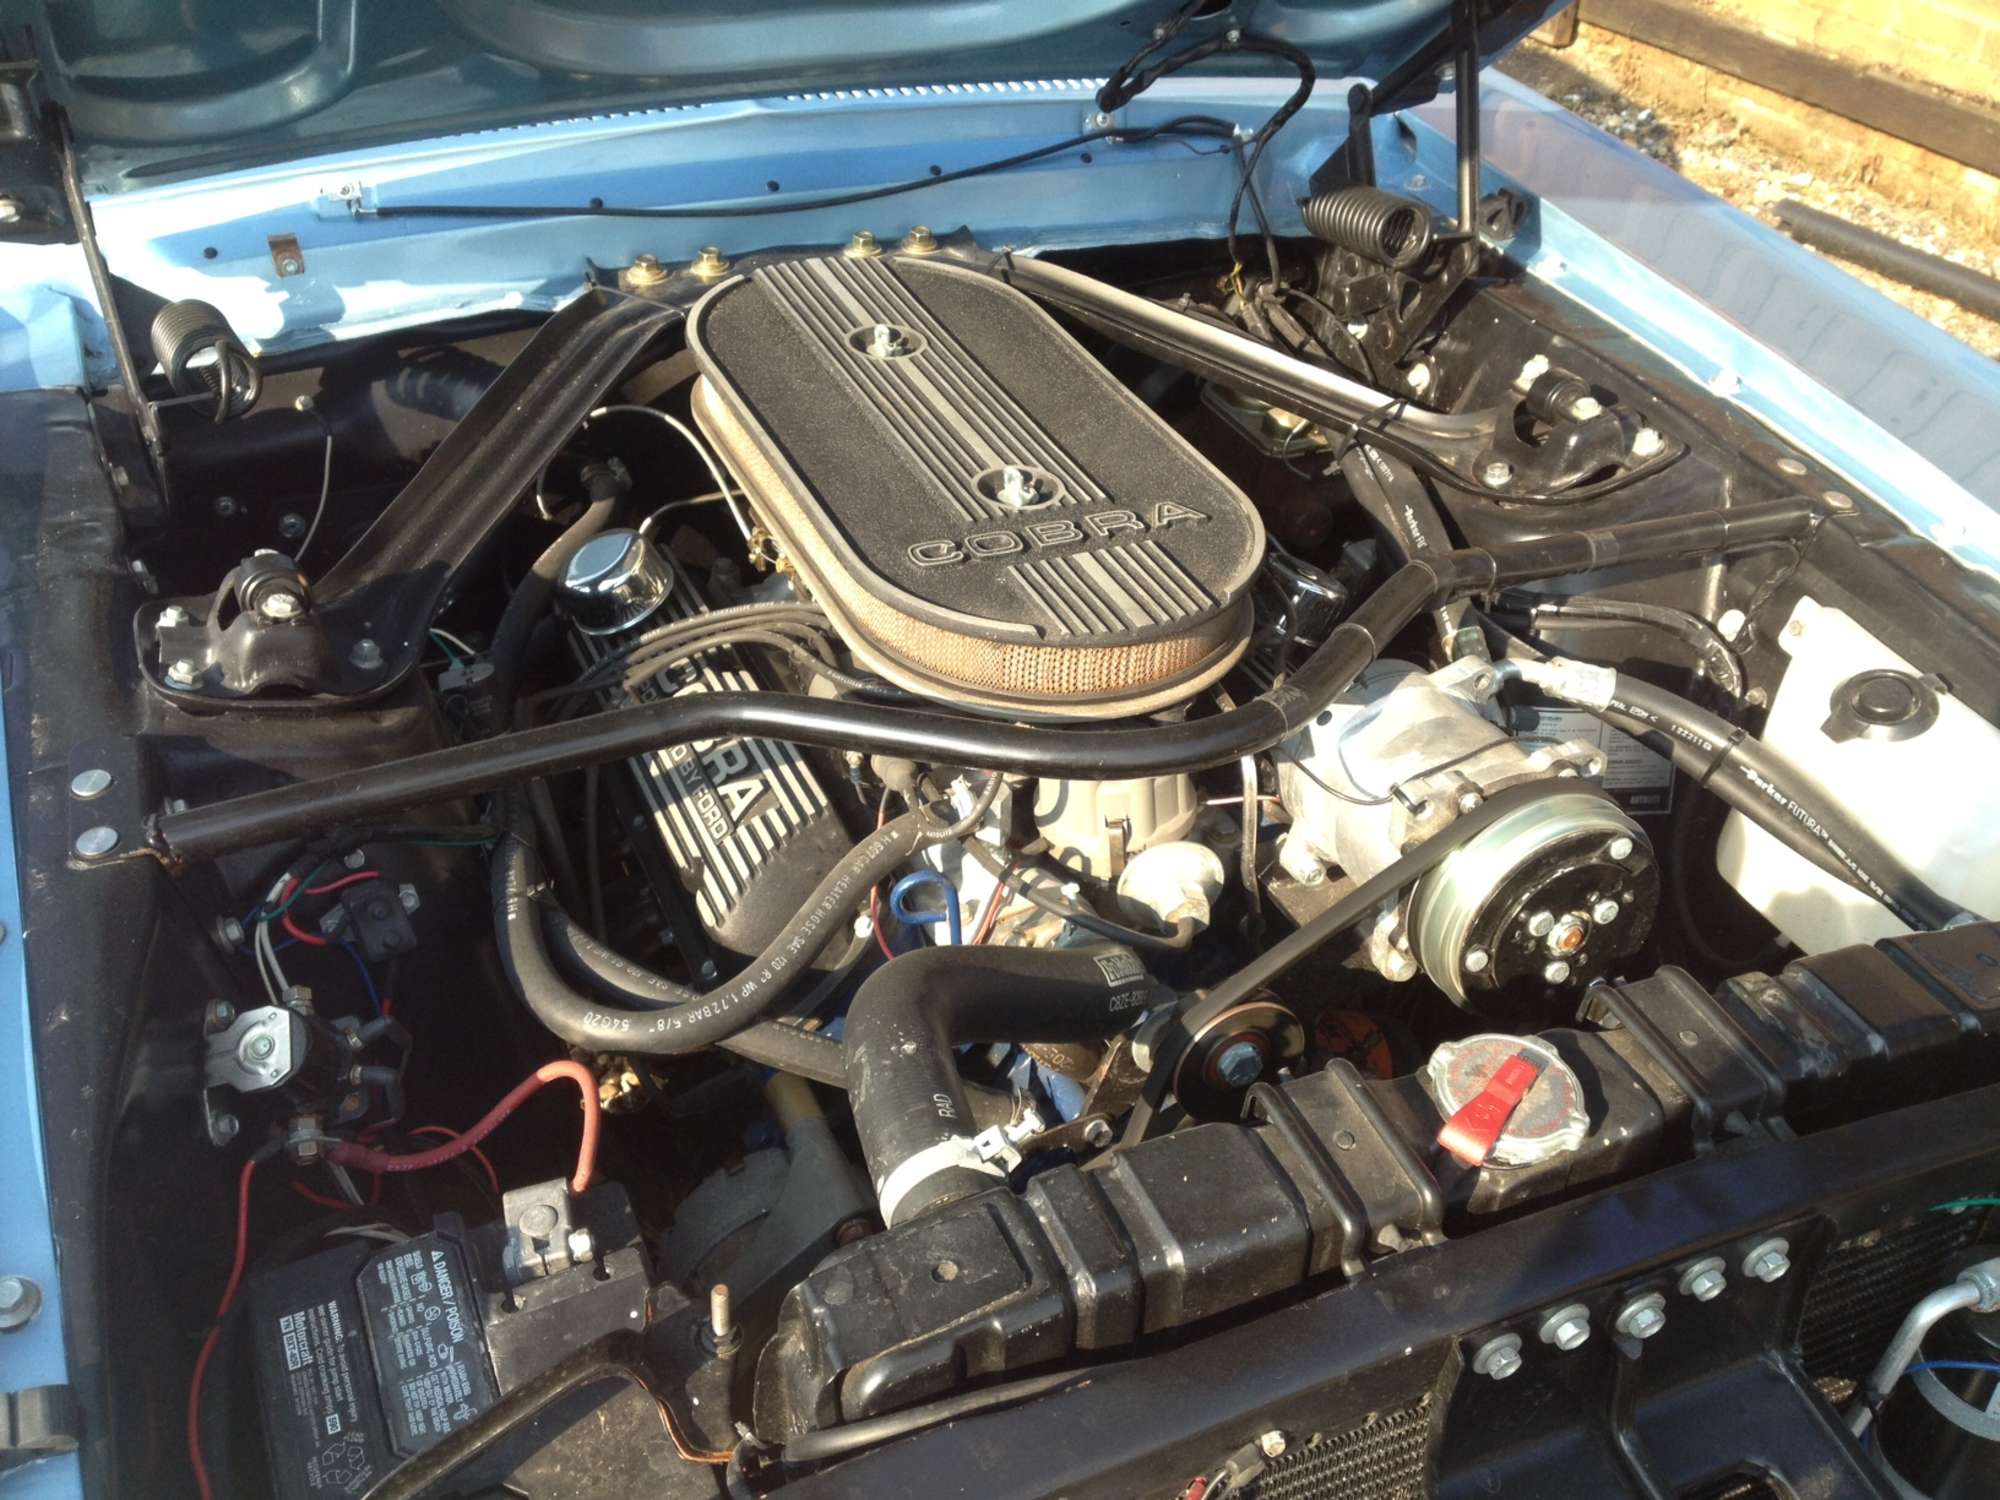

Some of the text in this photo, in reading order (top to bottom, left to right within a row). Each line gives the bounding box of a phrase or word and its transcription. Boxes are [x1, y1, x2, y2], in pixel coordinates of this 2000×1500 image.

[907, 500, 1211, 568] COBRA
[679, 760, 730, 844] BY FORD
[820, 872, 854, 912] HEATER
[800, 906, 826, 936] HOSE
[785, 933, 805, 954] SAE
[933, 1093, 959, 1119] RAD
[328, 1300, 343, 1343] WARNING:
[435, 1260, 453, 1299] DANGER
[445, 1306, 464, 1342] POISON
[293, 1311, 314, 1365] Motorcraft
